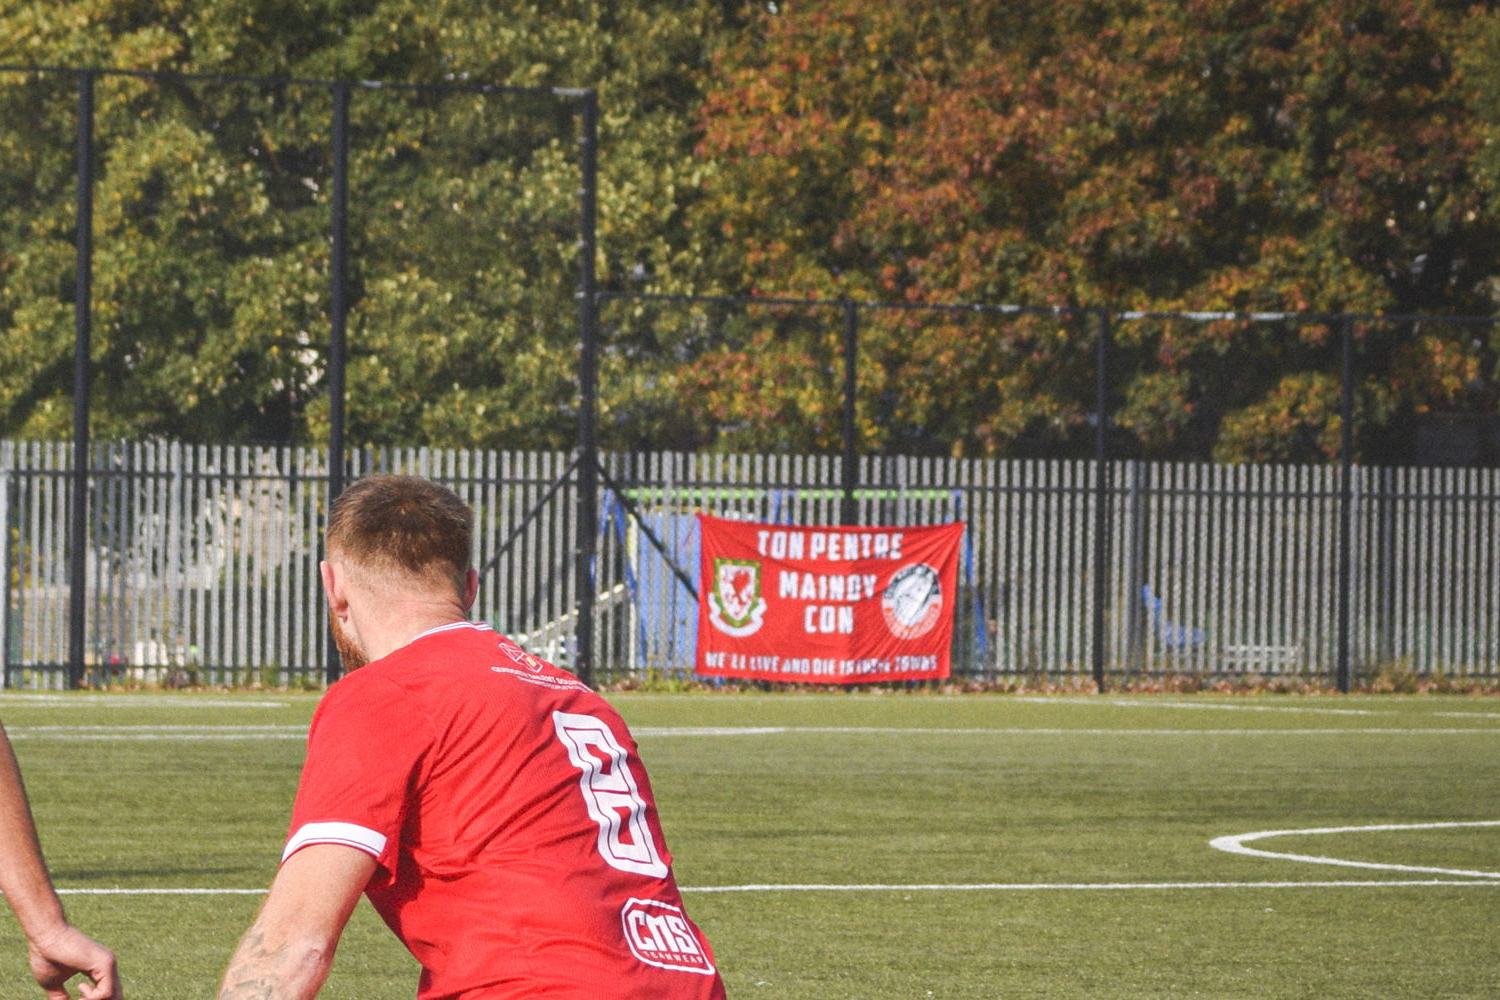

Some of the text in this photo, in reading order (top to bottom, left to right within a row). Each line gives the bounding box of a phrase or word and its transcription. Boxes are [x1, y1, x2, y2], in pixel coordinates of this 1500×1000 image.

[757, 530, 904, 562] TON PENTRE
[778, 570, 878, 602] MAINDY
[804, 605, 854, 634] CON
[781, 658, 810, 675] AND
[553, 710, 668, 879] 8
[627, 909, 699, 955] CMS
[643, 950, 703, 964] TEAMWEAR
